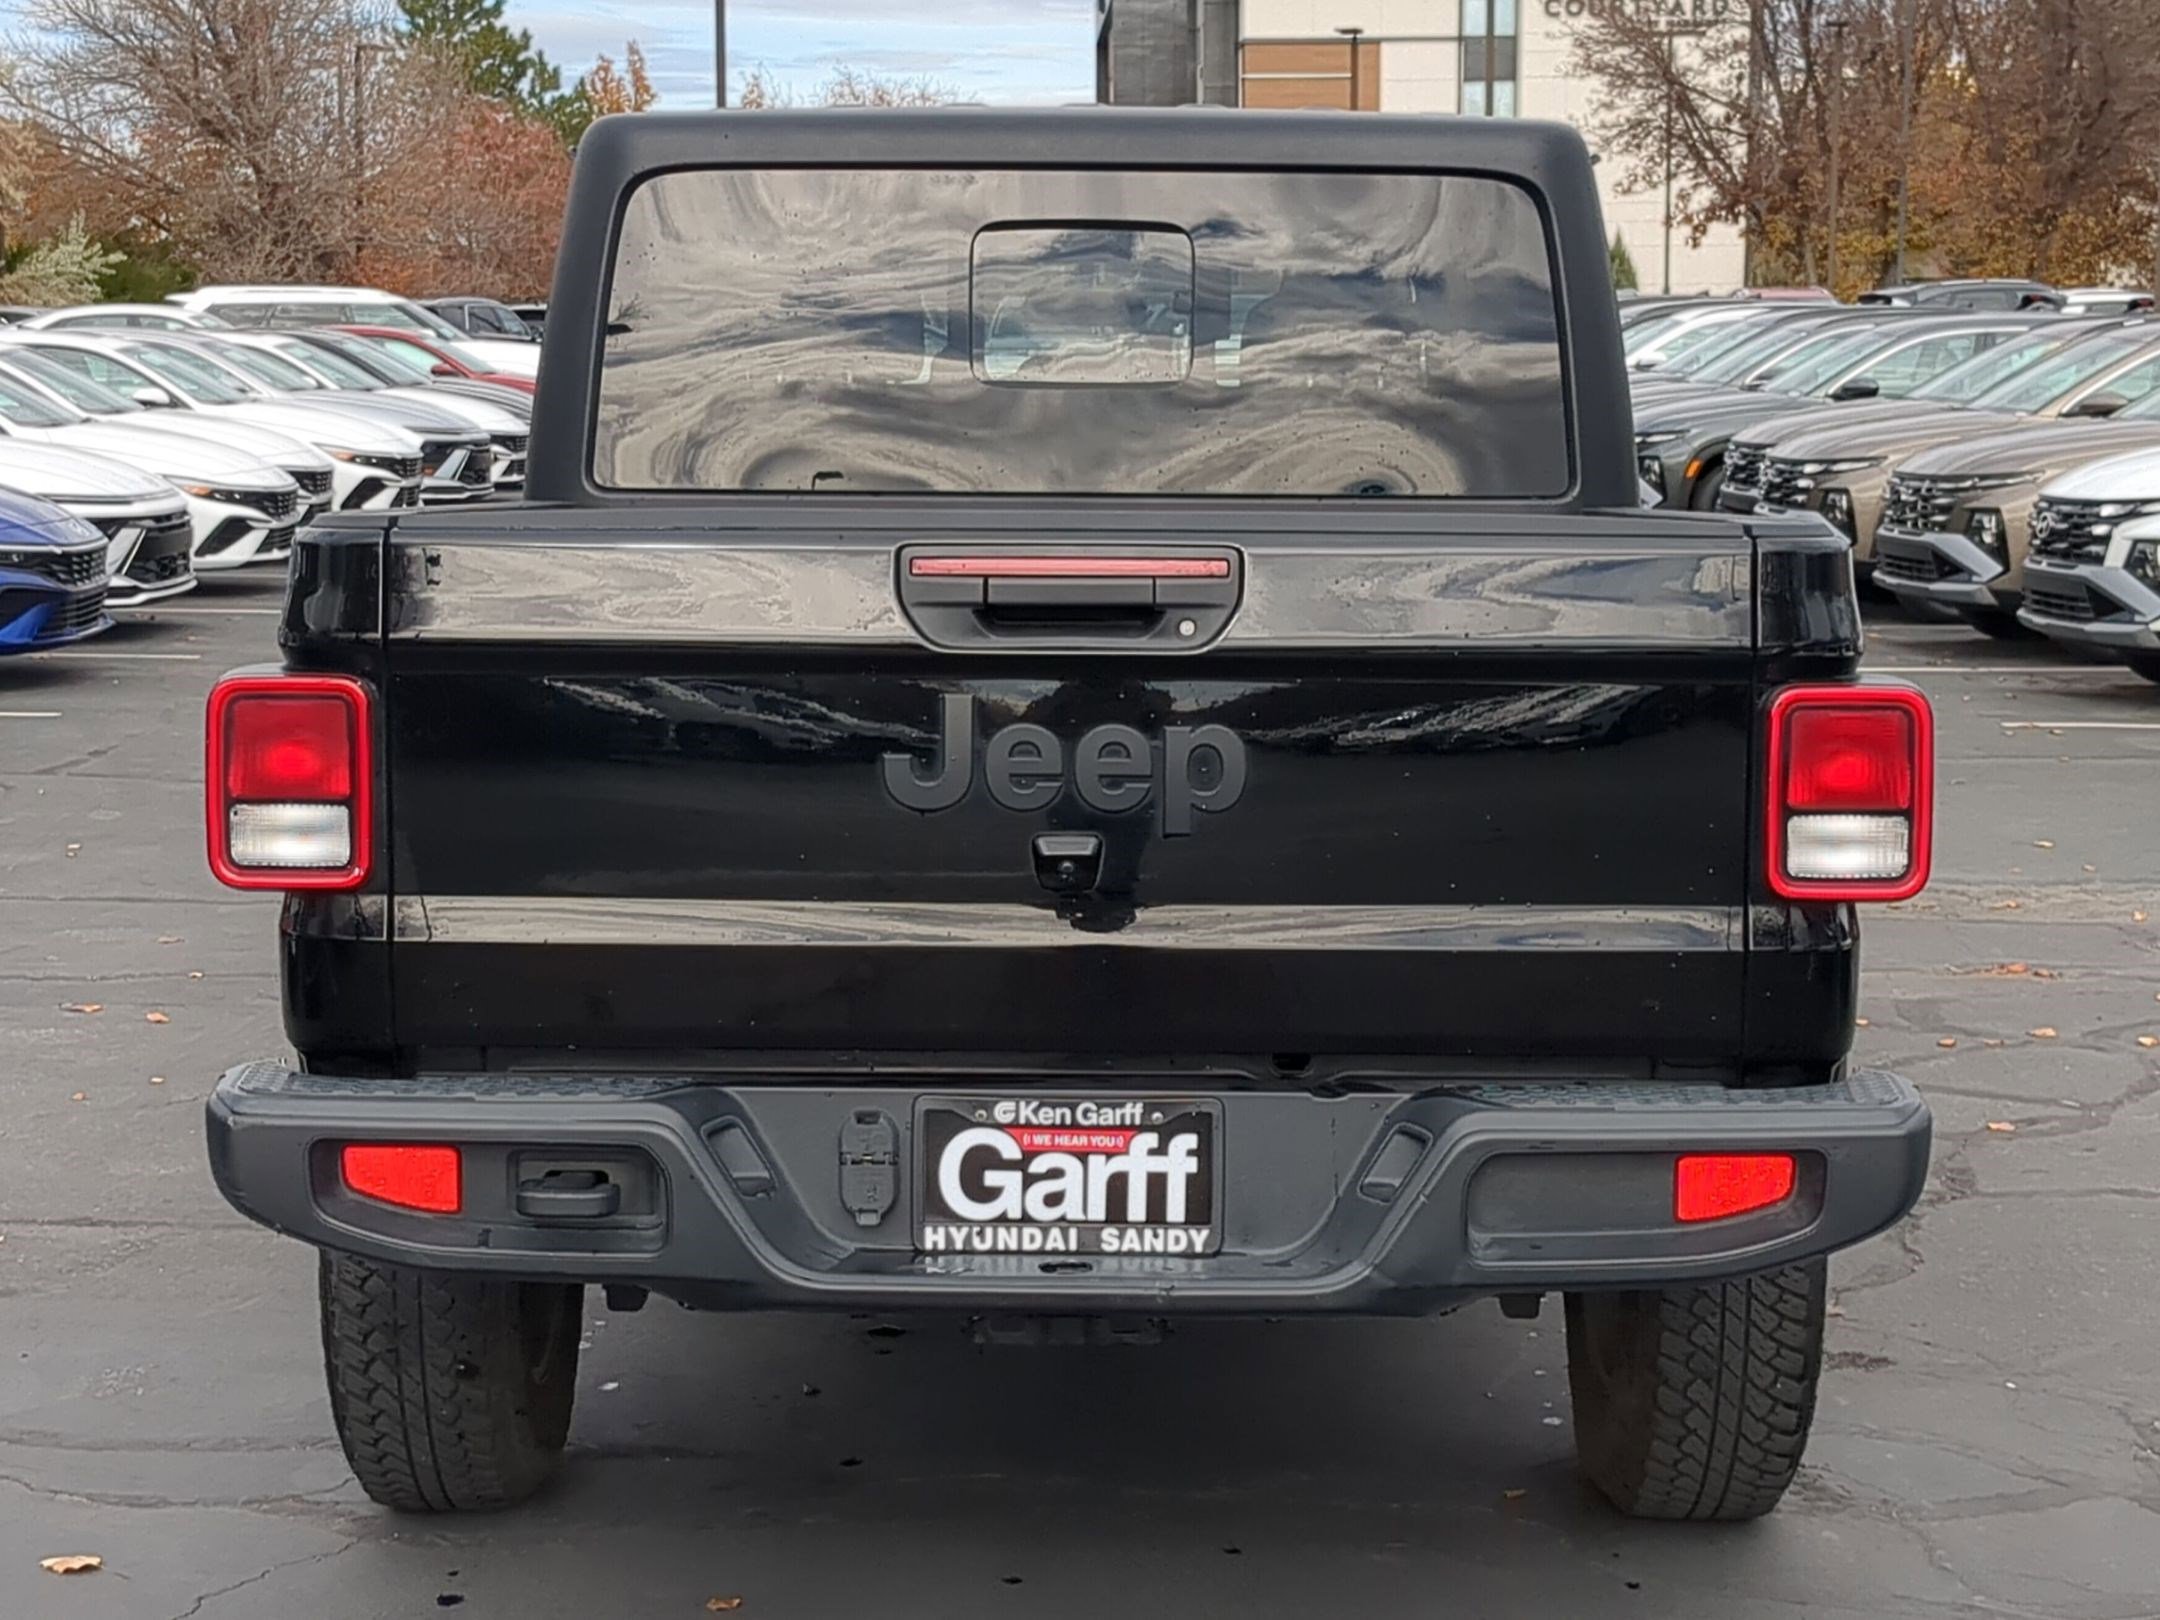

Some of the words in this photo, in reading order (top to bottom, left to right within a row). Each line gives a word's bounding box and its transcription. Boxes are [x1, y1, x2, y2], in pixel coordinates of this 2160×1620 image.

[882, 693, 1247, 837] Jeep
[1018, 1101, 1071, 1125] Ken
[1076, 1102, 1144, 1126] Garff
[1032, 1134, 1051, 1146] WE
[1054, 1134, 1088, 1147] HEAR
[938, 1127, 1198, 1223] Garff
[924, 1227, 1078, 1251] HYUNDAI
[1100, 1228, 1211, 1253] SANDY
